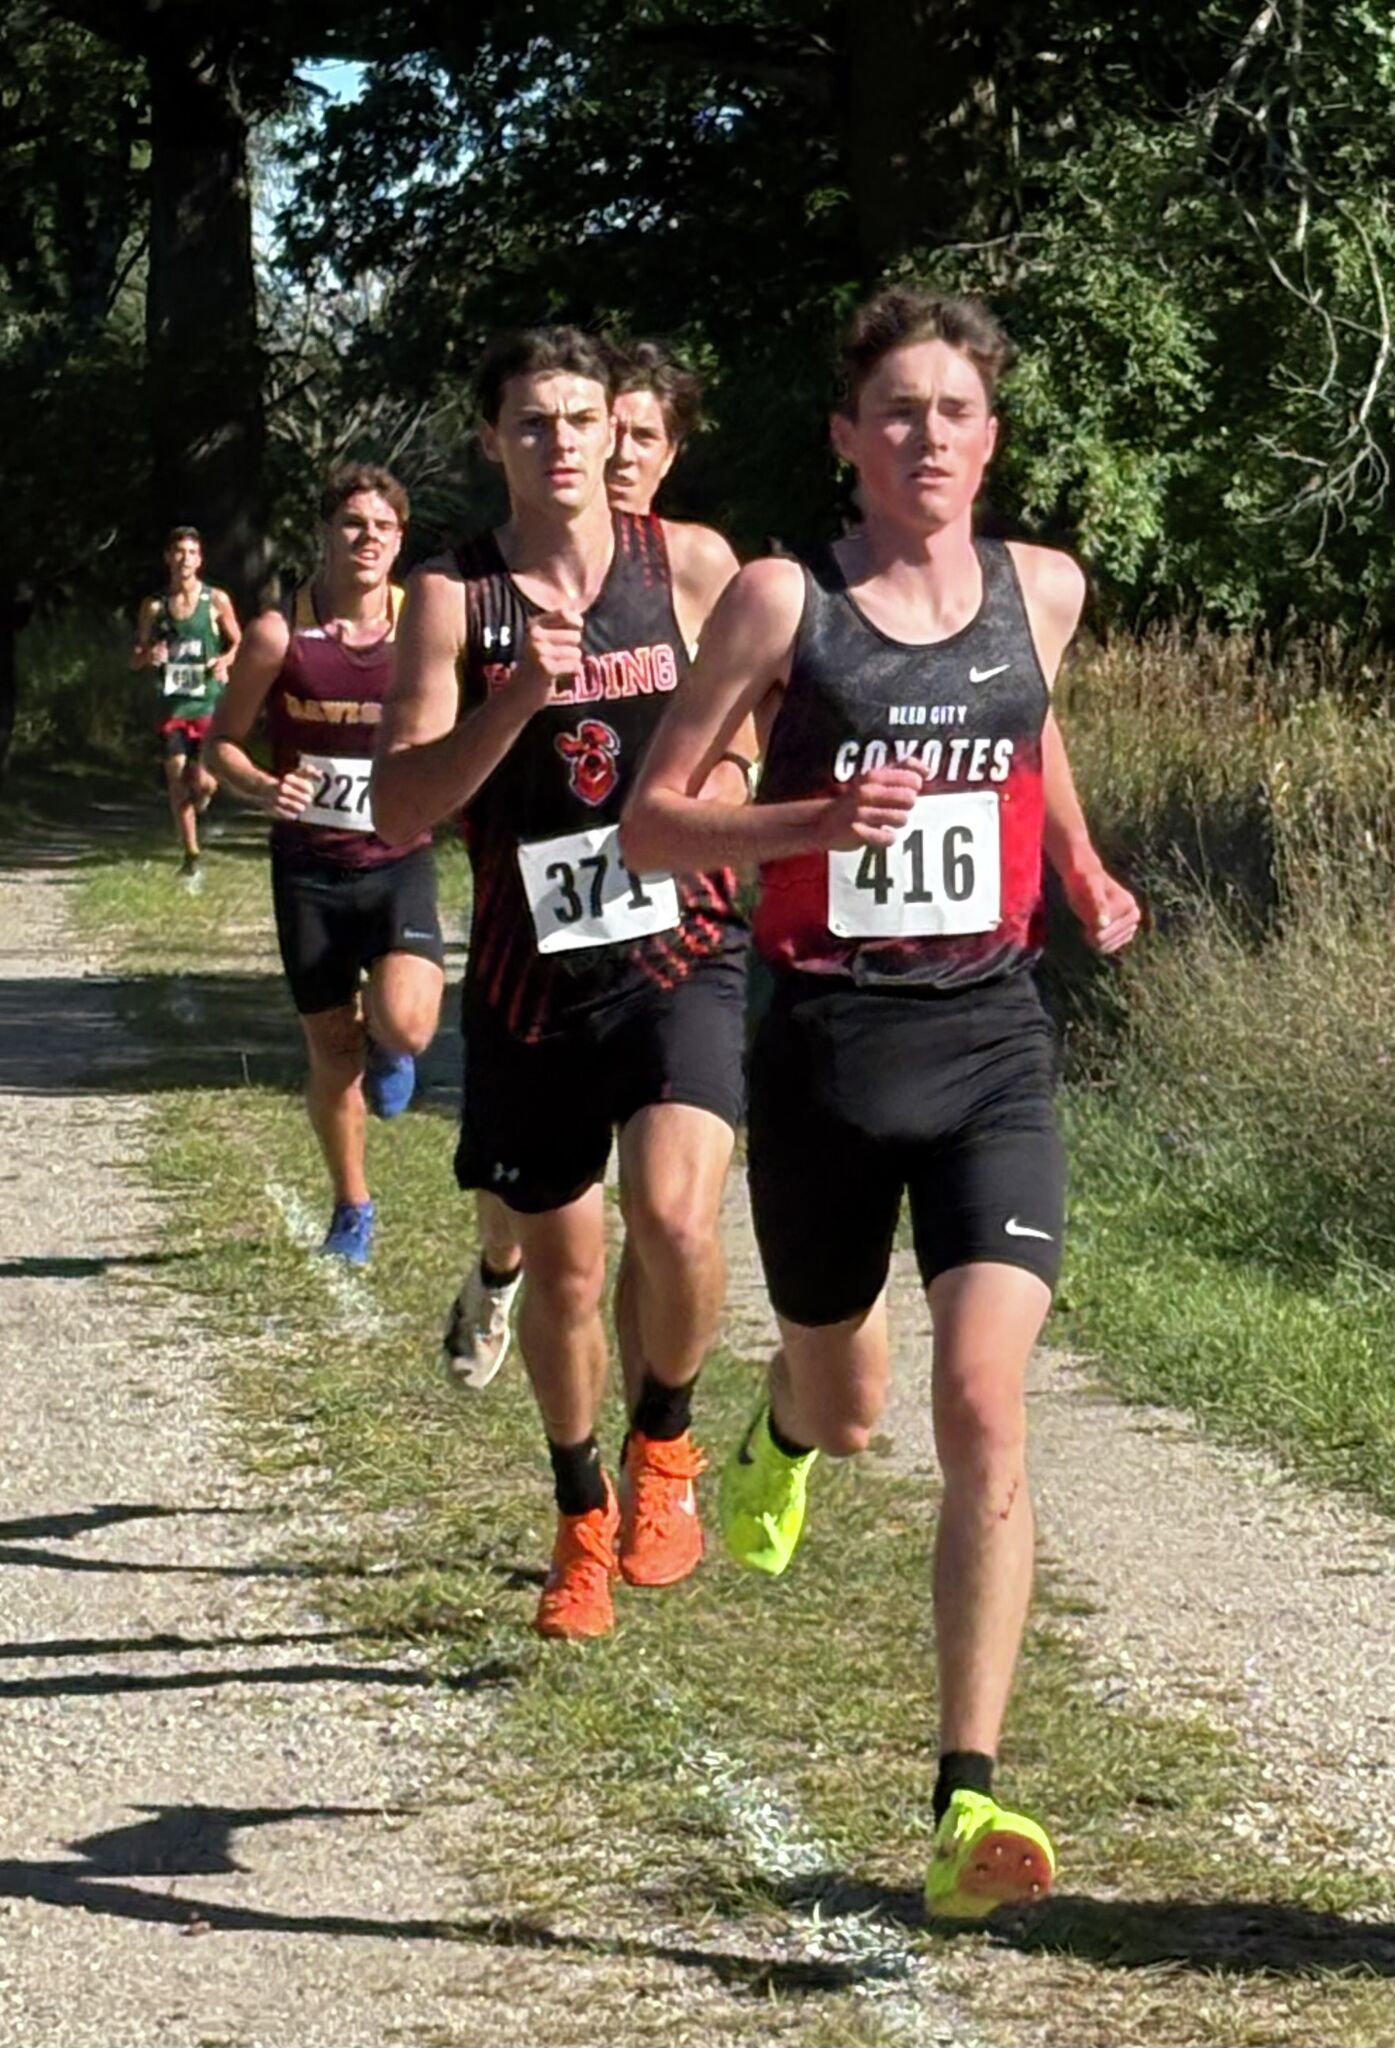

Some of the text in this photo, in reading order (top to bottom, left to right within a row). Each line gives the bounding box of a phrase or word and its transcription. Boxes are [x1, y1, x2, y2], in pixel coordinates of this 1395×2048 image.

[930, 704, 968, 725] CITY
[834, 738, 1014, 783] COYOTES
[313, 772, 371, 813] 227
[855, 825, 976, 905] 416
[545, 854, 654, 924] 371
